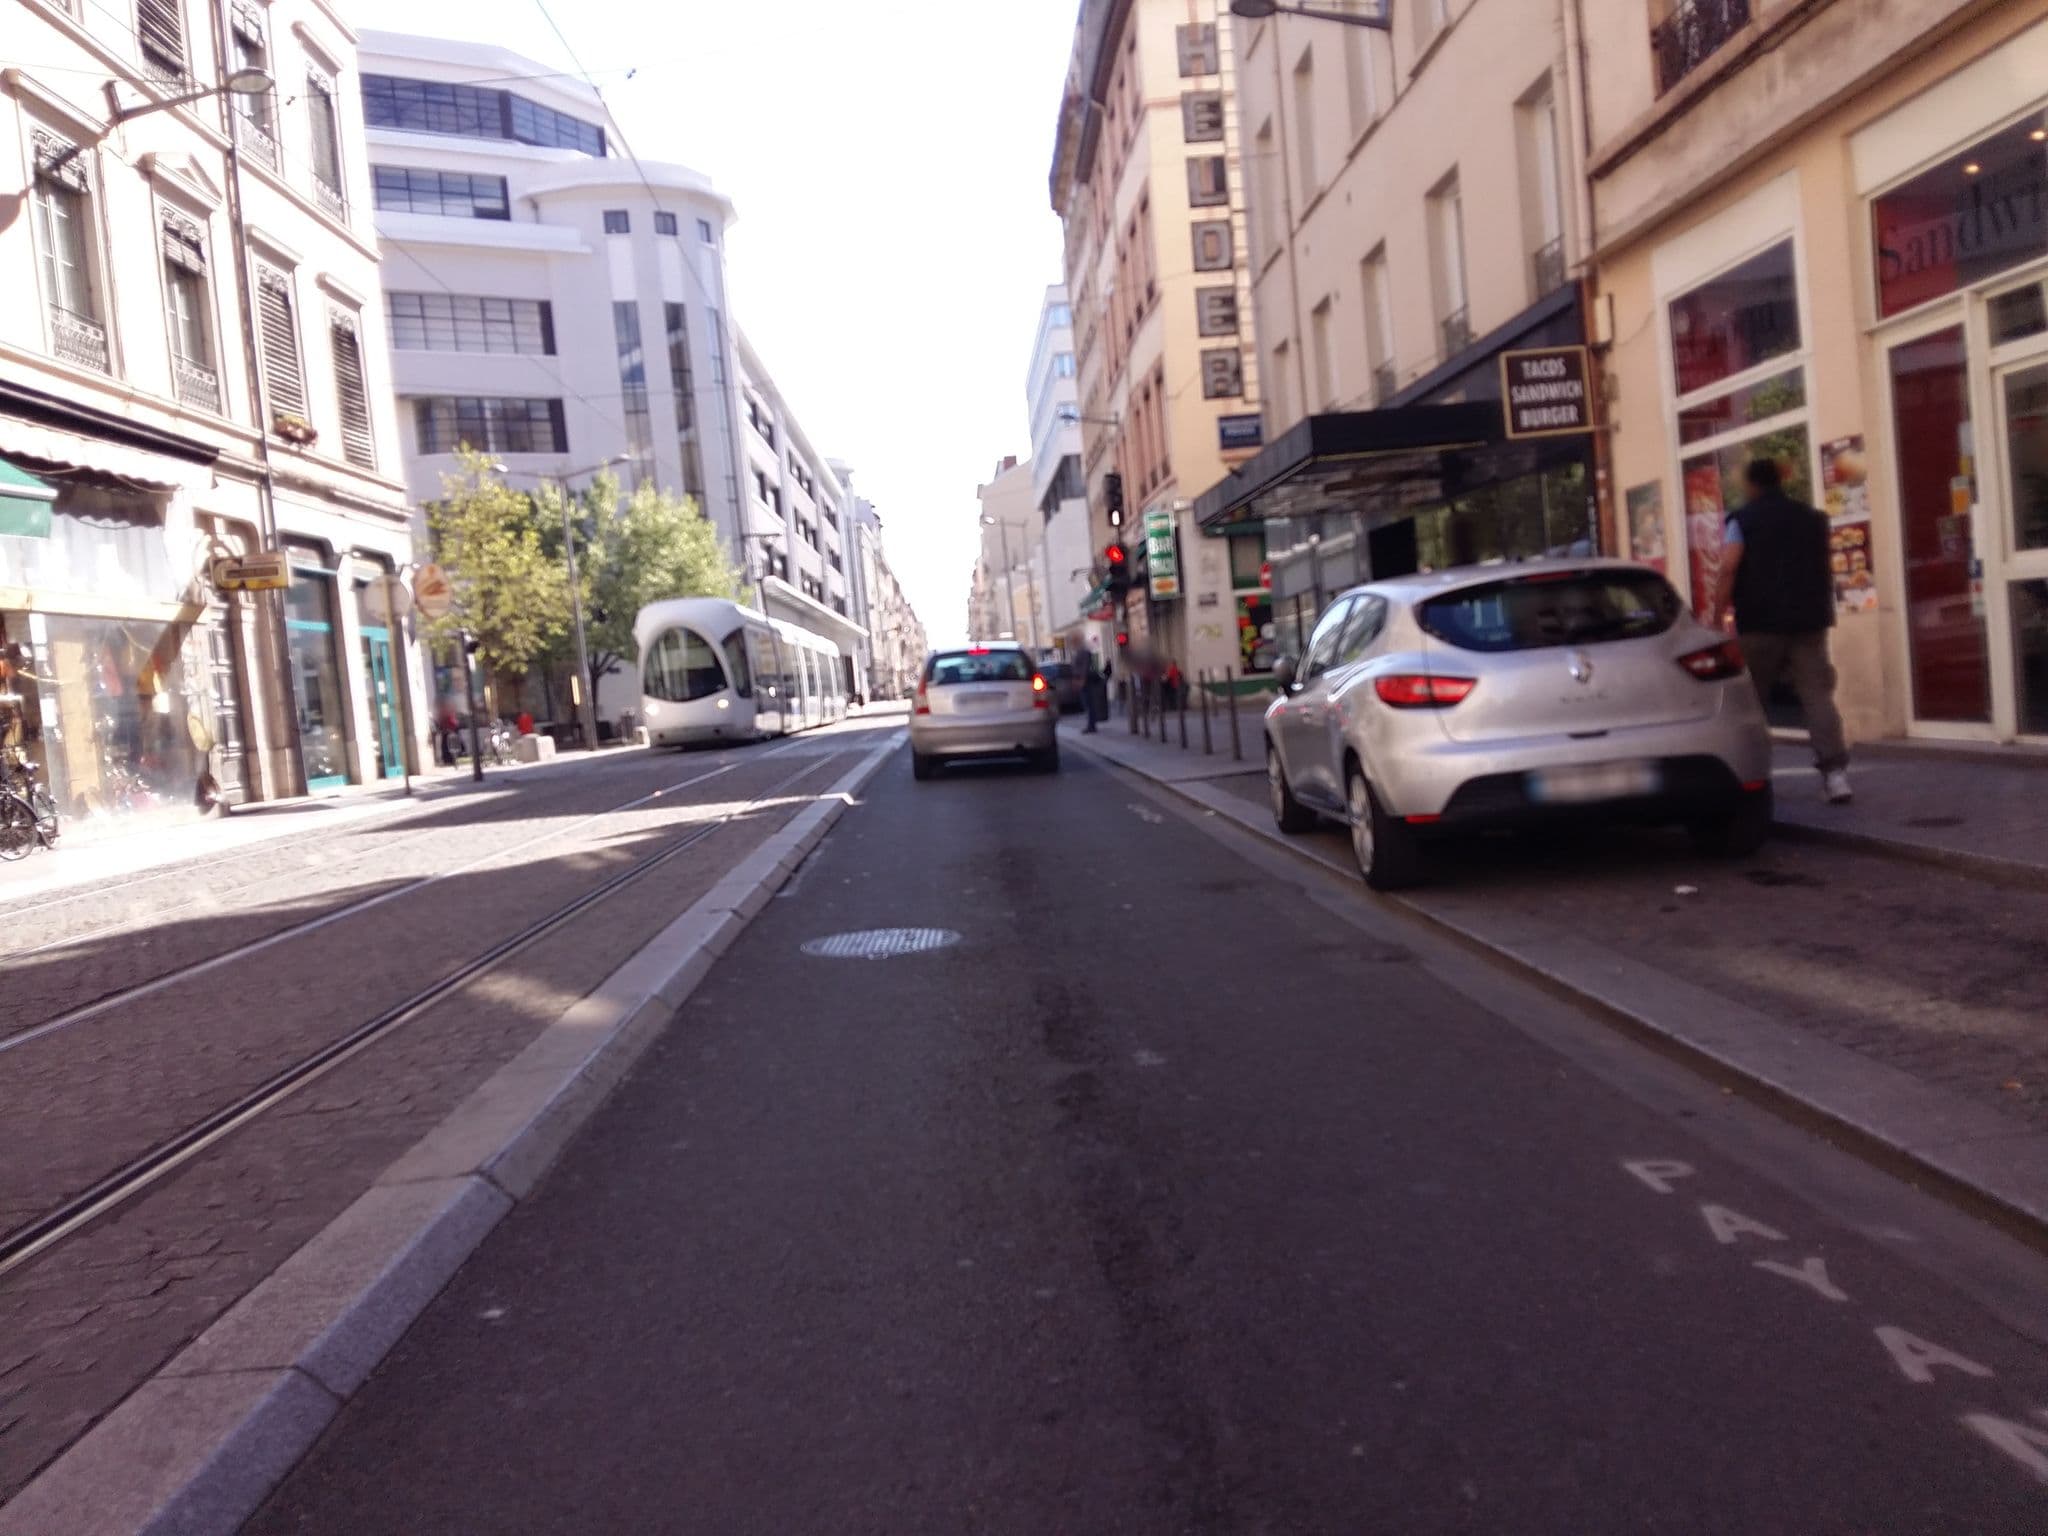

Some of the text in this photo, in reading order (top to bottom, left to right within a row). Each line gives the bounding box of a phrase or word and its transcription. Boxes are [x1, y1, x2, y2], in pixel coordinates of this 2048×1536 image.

[1521, 358, 1567, 379] TACOS
[1512, 380, 1583, 402] SANDWICH
[1520, 404, 1579, 428] BURGER
